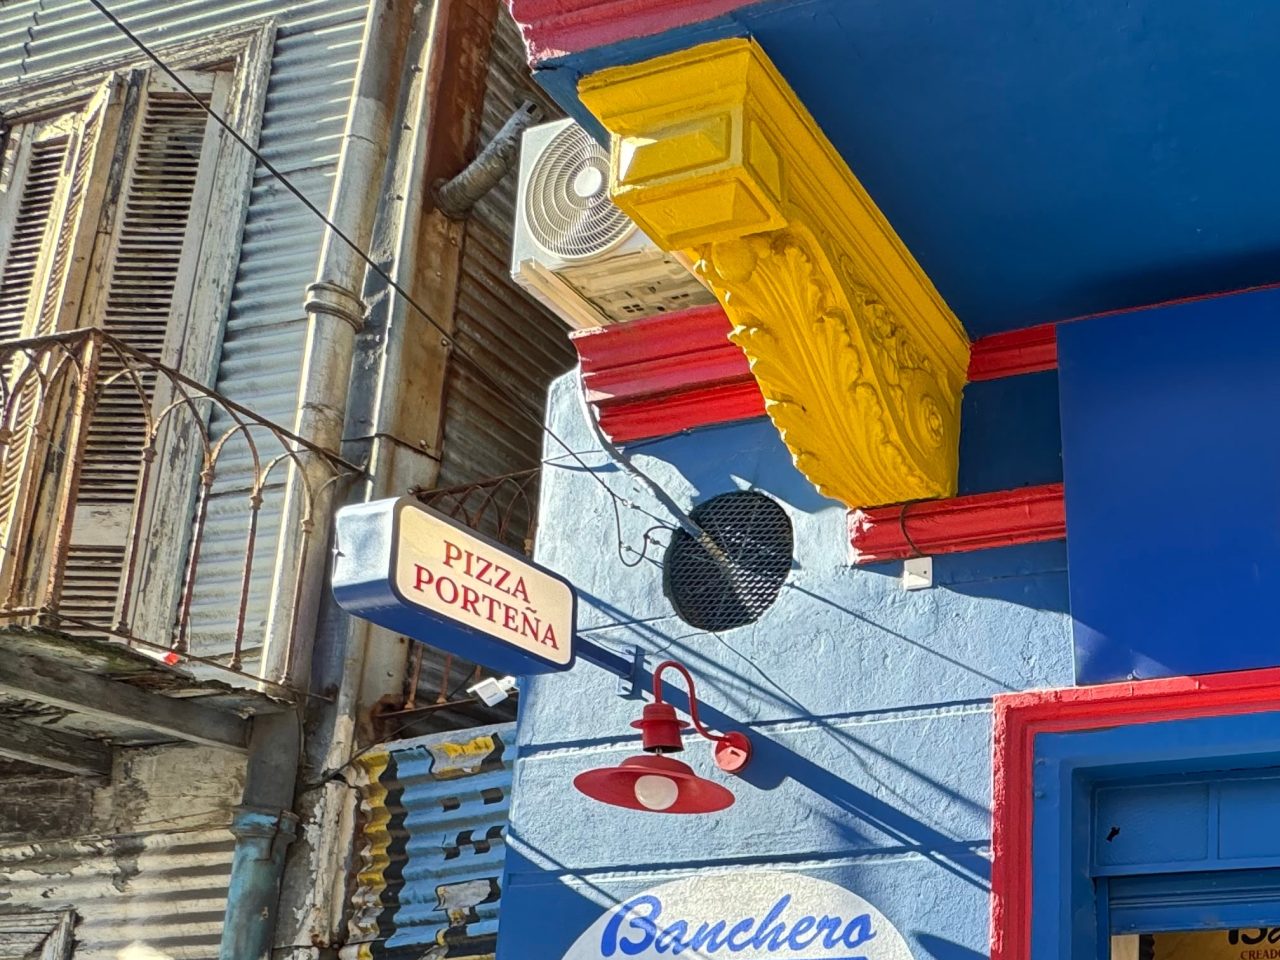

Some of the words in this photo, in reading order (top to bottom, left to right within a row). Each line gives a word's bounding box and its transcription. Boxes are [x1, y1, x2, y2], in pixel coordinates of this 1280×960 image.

[443, 540, 531, 604] PIZZA
[413, 563, 560, 651] PORTEÑA
[601, 894, 877, 958] Banchero
